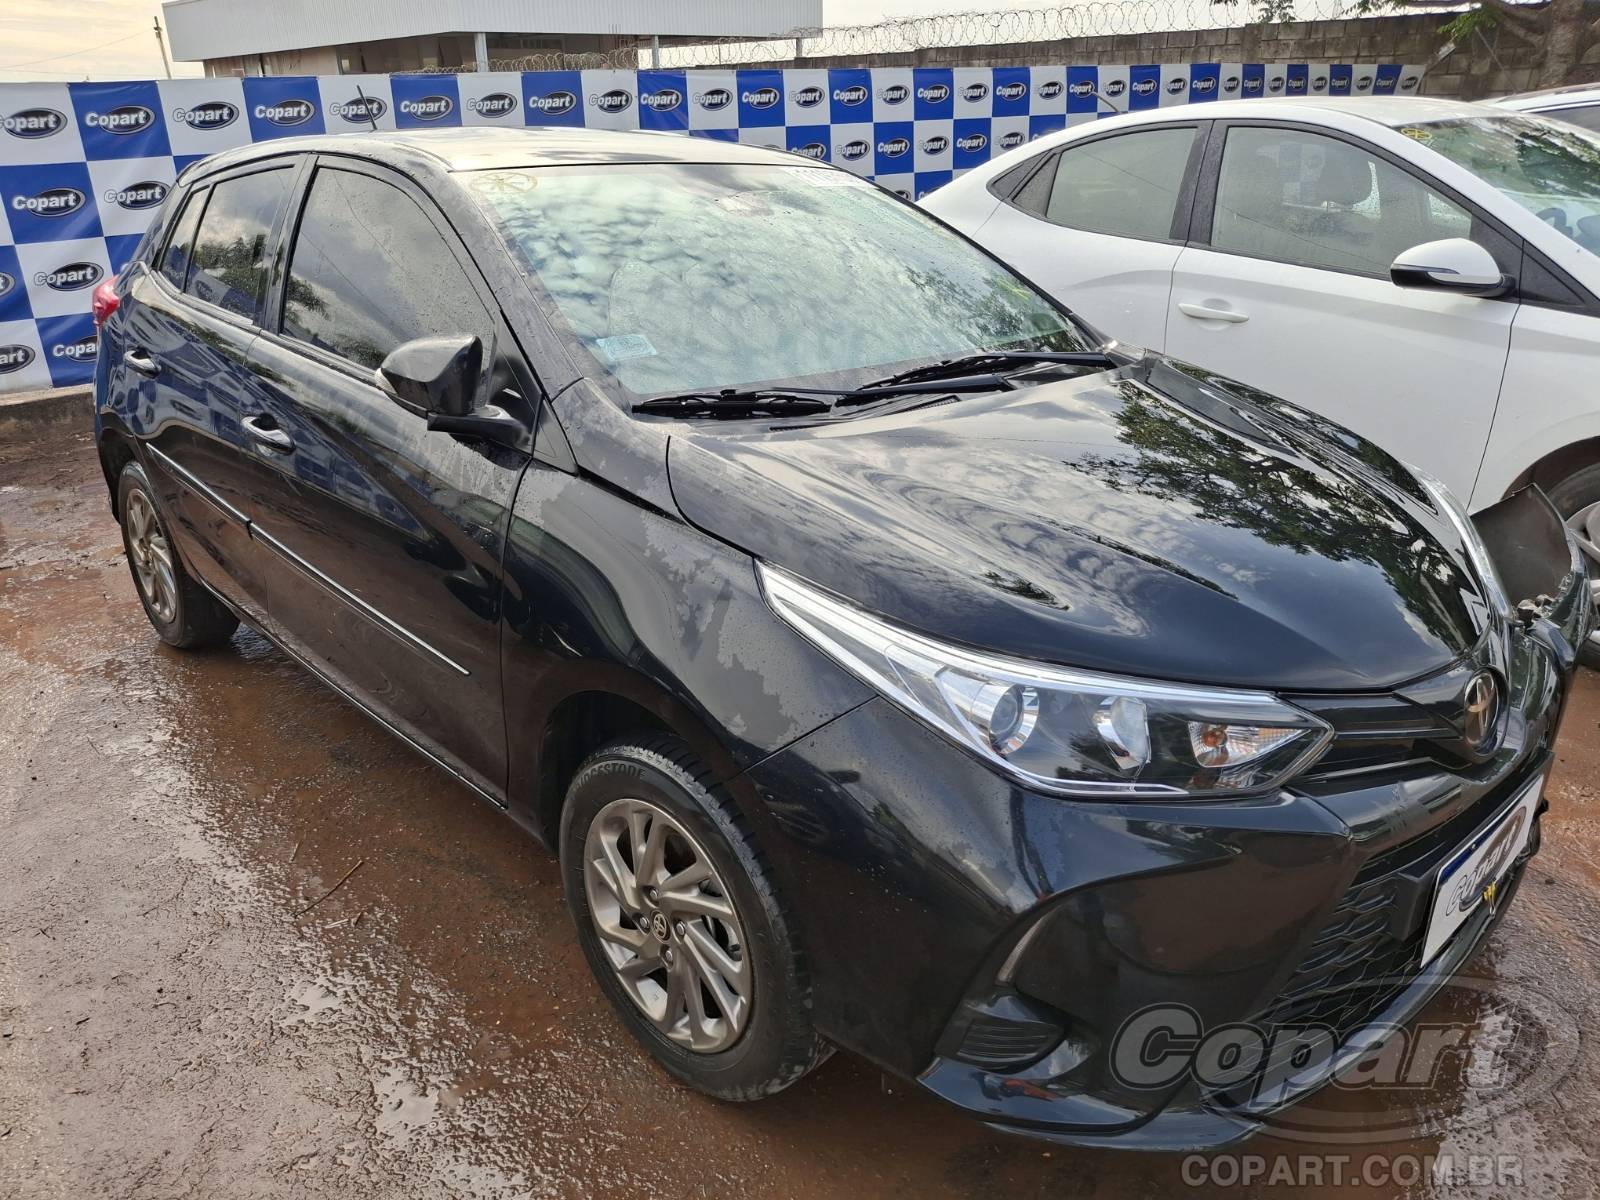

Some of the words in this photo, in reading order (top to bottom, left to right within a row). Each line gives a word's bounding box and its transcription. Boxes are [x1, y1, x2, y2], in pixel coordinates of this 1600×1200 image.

[996, 84, 1023, 97] Copart
[1036, 84, 1060, 95] opart
[1069, 83, 1092, 95] Copart
[1132, 81, 1156, 92] Copart
[1164, 81, 1184, 91] opart
[1192, 79, 1214, 90] Copart
[693, 92, 728, 106] Copart
[742, 90, 777, 103] Copart
[789, 89, 822, 103] Copart
[833, 88, 864, 102] Copart
[877, 87, 906, 101] Copart
[917, 86, 946, 99] Copart
[959, 85, 986, 99] Copart
[400, 100, 446, 114] Copart
[467, 98, 512, 112] Copart
[529, 96, 572, 110] Copart
[588, 94, 629, 108] Copart
[640, 94, 679, 107] Copart
[173, 107, 230, 122] Copart
[254, 105, 307, 120] Copart
[329, 102, 379, 118] Copart
[0, 114, 56, 132] opart
[85, 111, 146, 129] Copart
[835, 143, 866, 157] Copart
[877, 141, 906, 154] Copart
[919, 138, 945, 152] Copart
[956, 137, 983, 150] Copart
[13, 192, 76, 210] Copart
[104, 188, 162, 205] Copart
[34, 267, 94, 286] Copart
[1446, 820, 1518, 916] Copart
